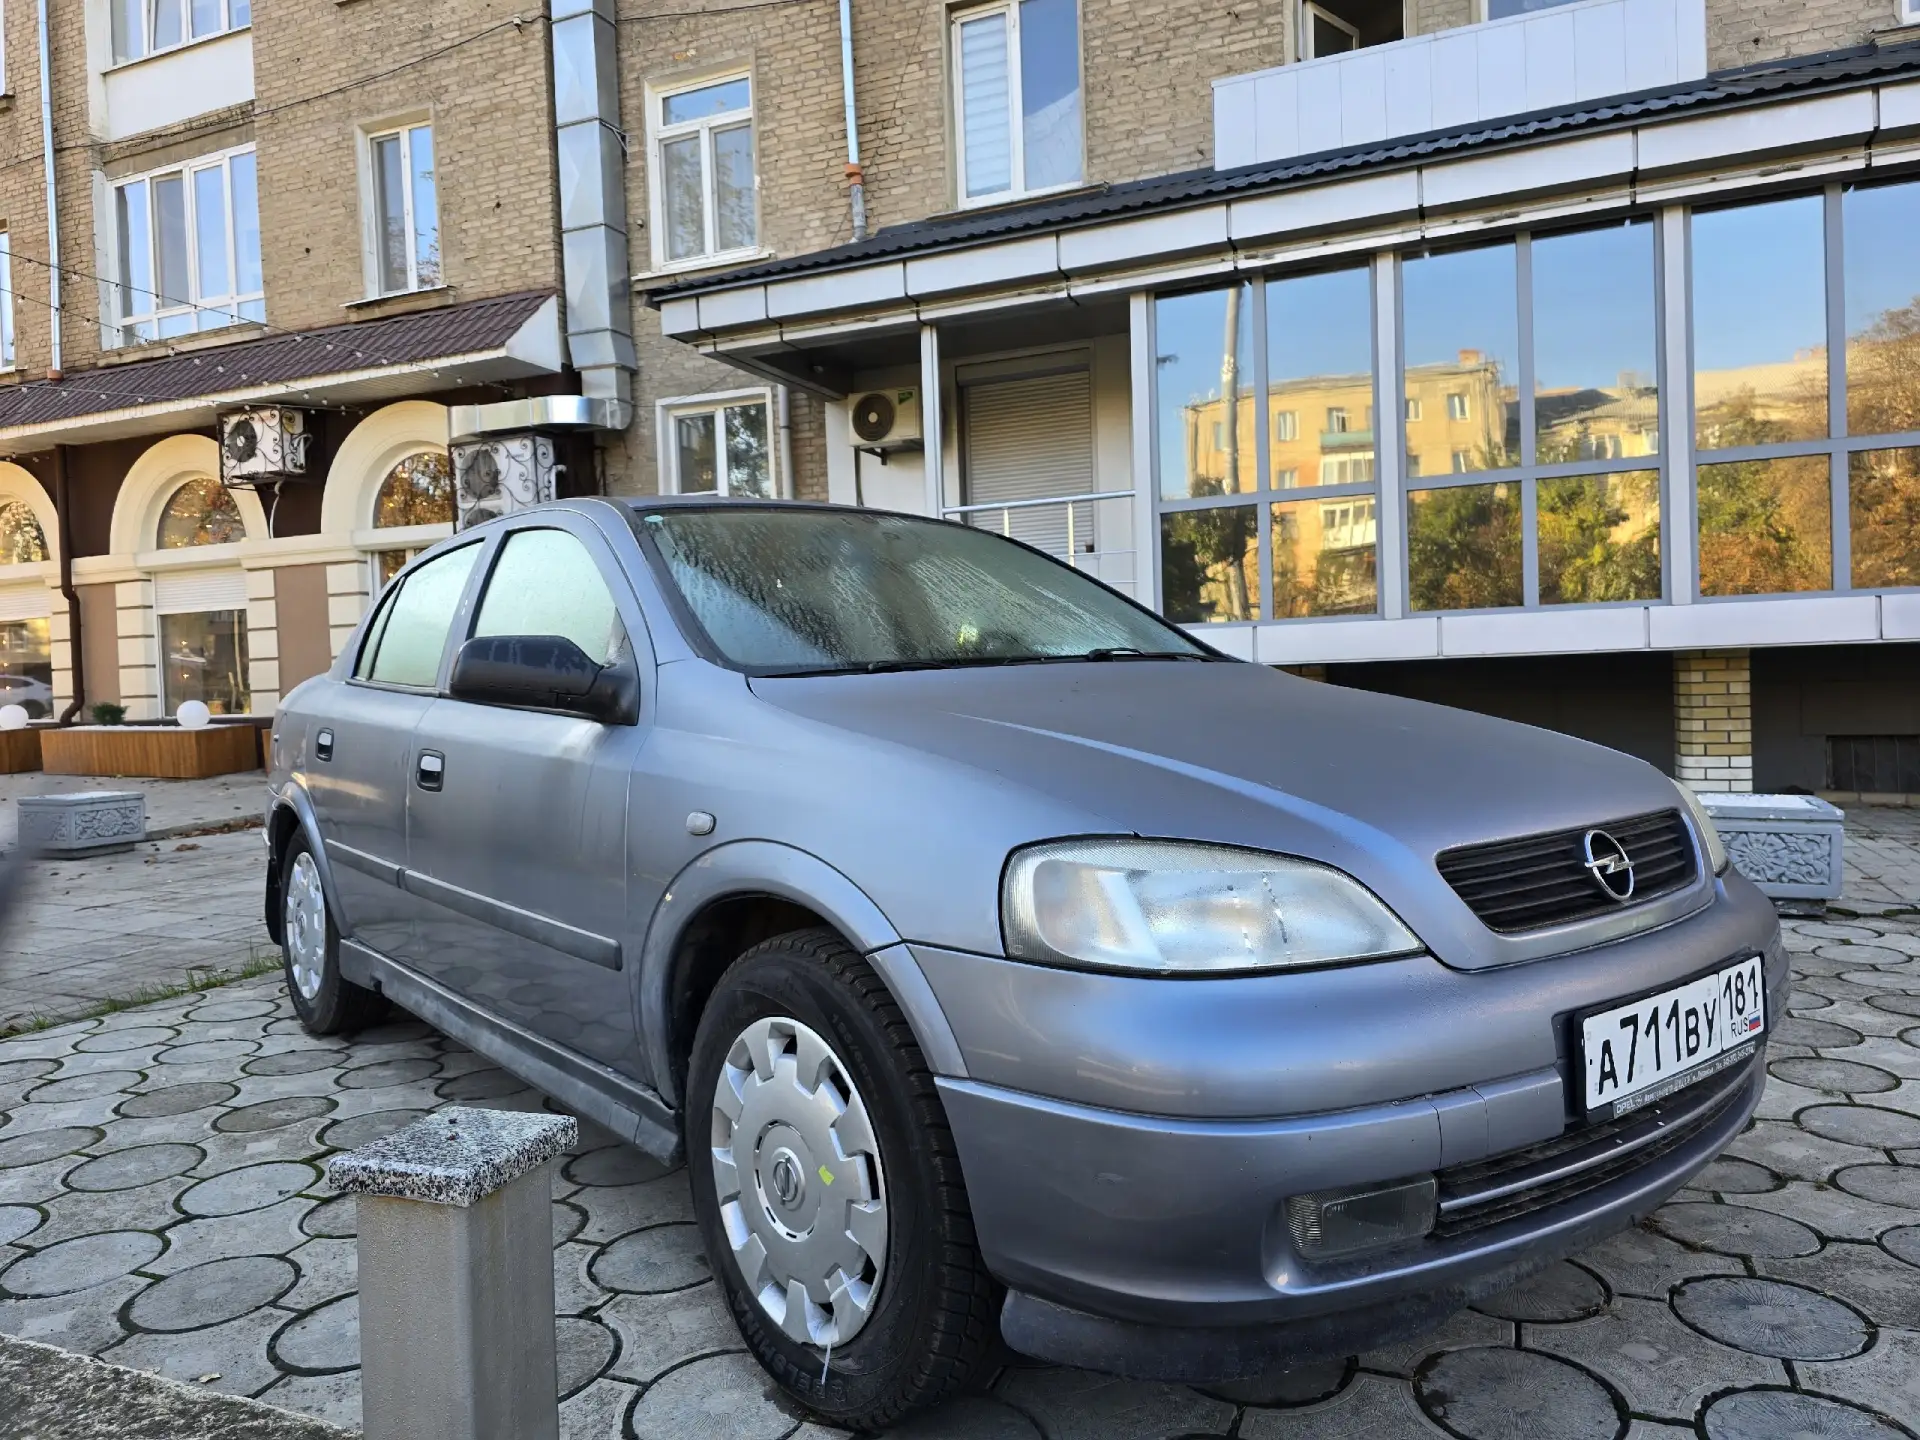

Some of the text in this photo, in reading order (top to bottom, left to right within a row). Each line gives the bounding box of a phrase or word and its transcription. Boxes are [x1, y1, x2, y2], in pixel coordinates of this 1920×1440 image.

[1723, 965, 1759, 1020] 181
[1731, 1016, 1749, 1038] RUS
[1616, 1097, 1636, 1114] OPEL
